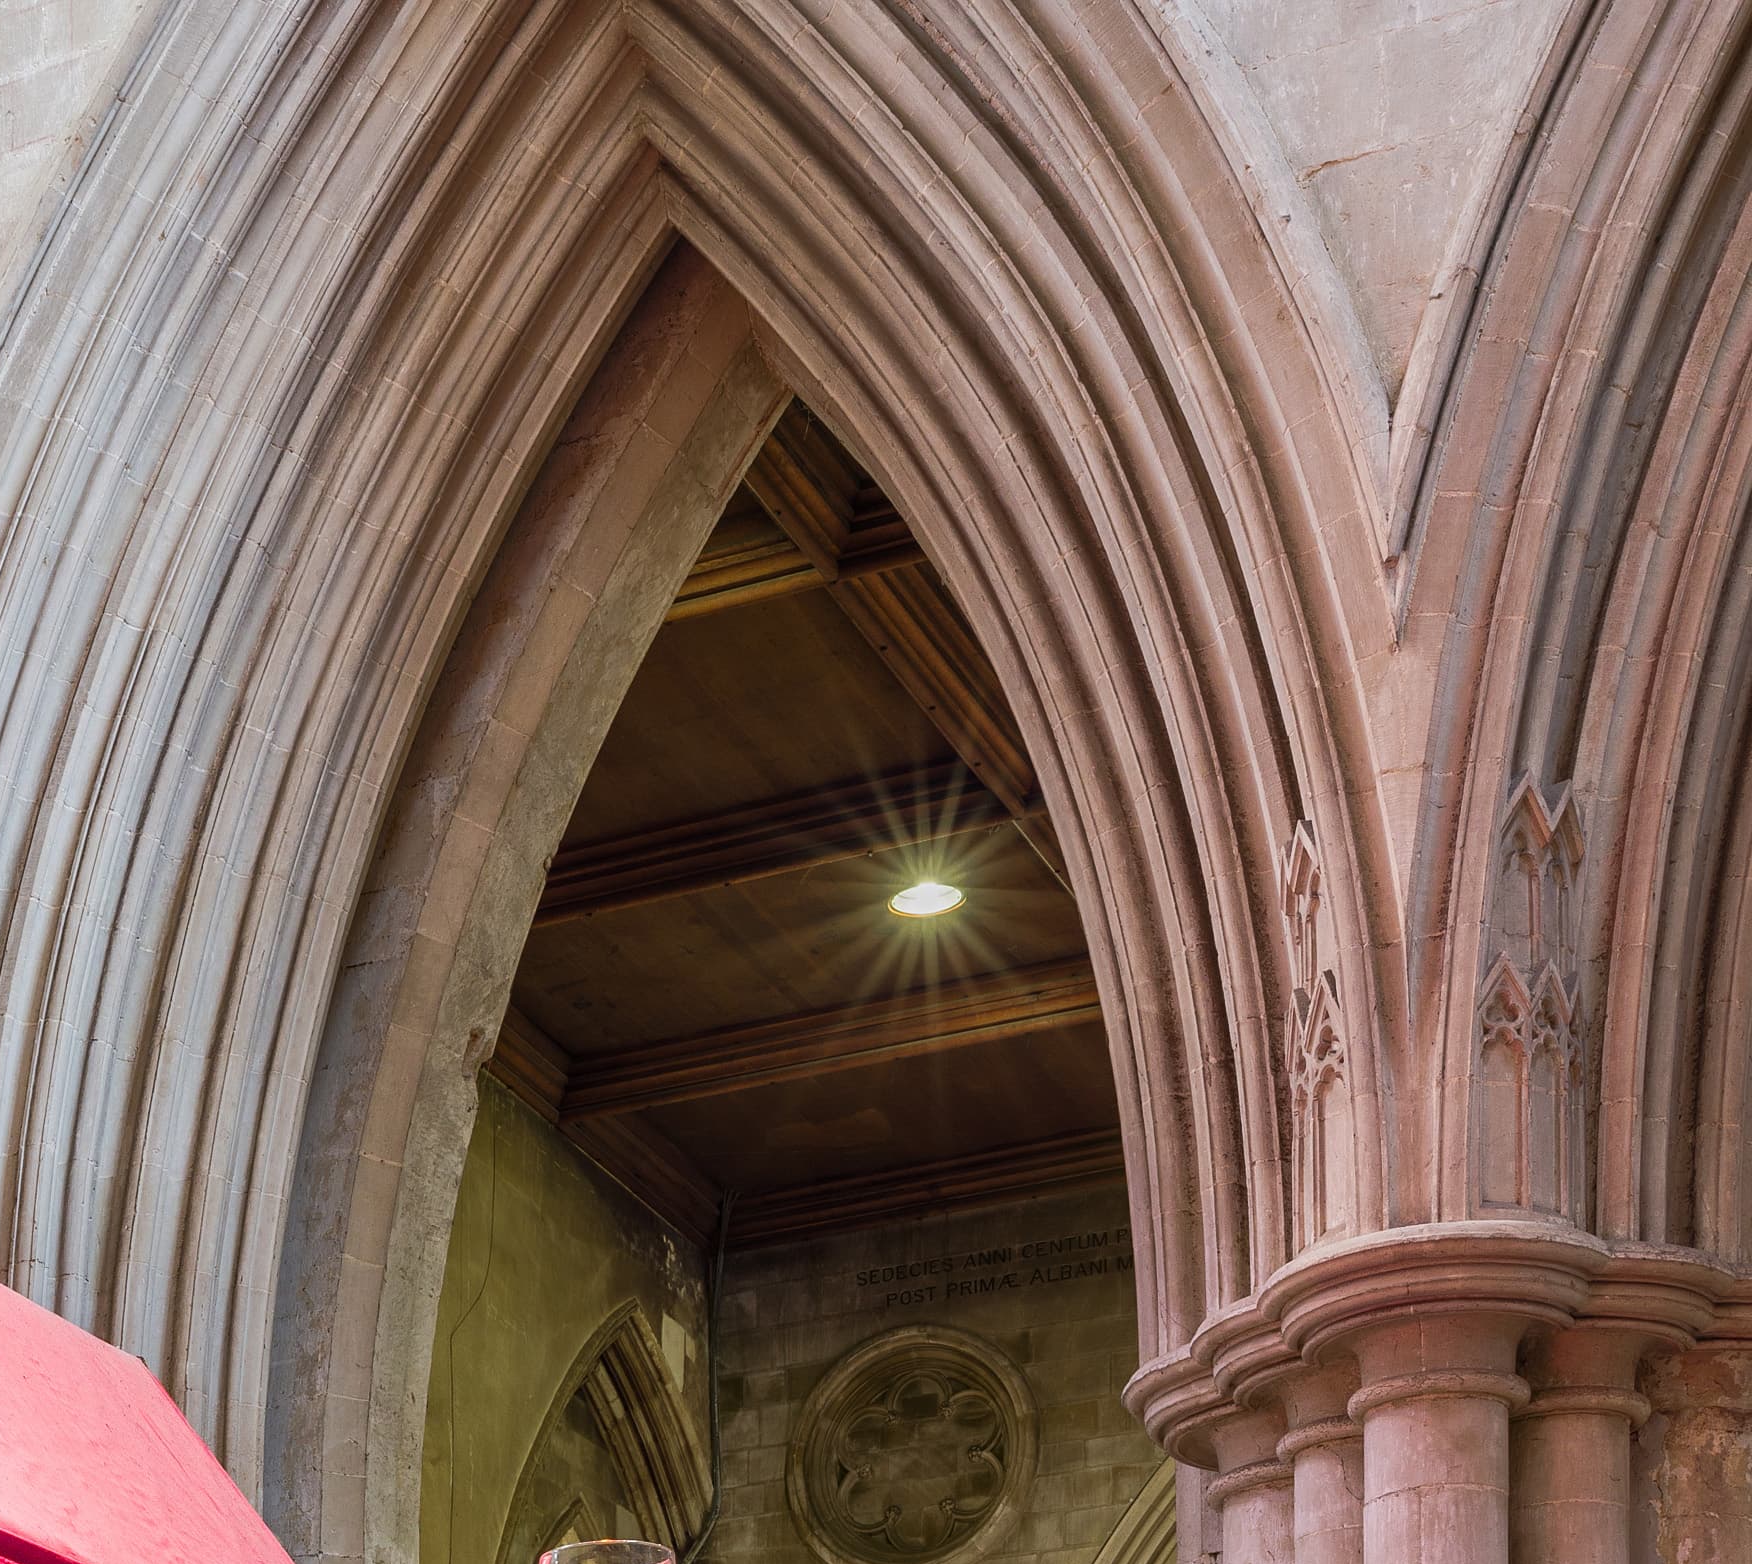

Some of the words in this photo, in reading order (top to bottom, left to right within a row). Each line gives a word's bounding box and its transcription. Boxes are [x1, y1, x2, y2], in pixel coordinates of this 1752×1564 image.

[856, 1258, 954, 1287] SEDECIES
[963, 1248, 1012, 1270] ANNI
[1021, 1231, 1109, 1259] CENTUM
[886, 1286, 937, 1307] POST
[1029, 1258, 1108, 1285] ALBANI
